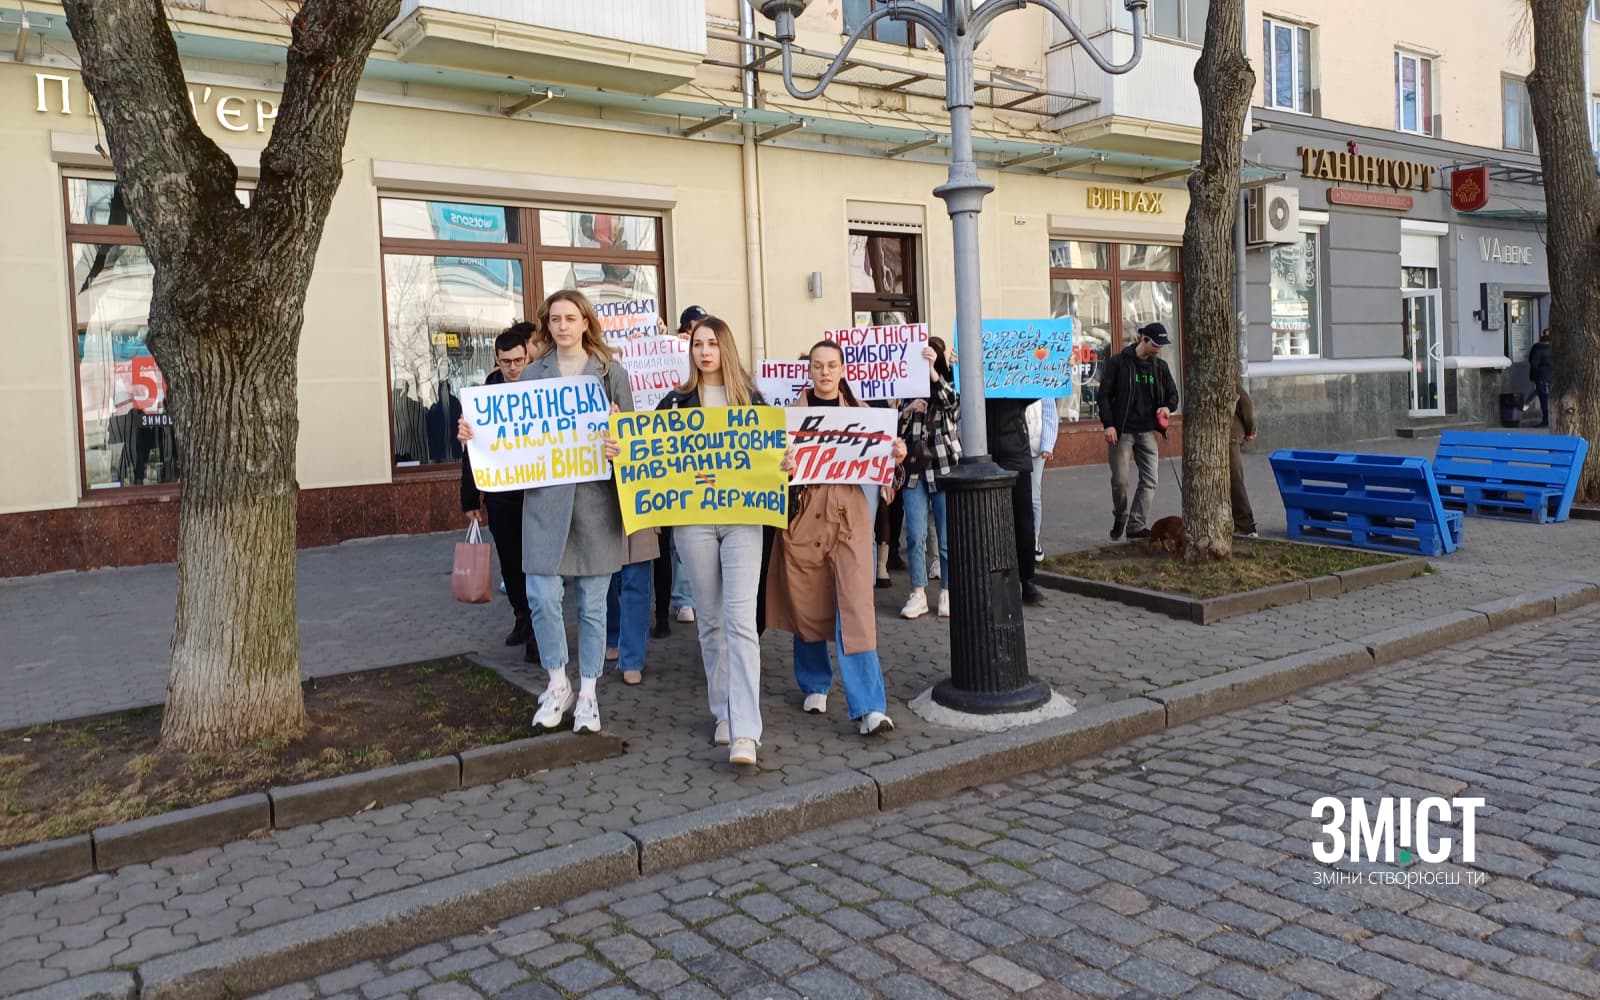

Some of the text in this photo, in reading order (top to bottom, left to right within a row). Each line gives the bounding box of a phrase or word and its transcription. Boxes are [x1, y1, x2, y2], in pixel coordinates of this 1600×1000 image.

[1088, 187, 1164, 213] ВІНТАЖ
[845, 344, 907, 364] ВИБОРУ
[846, 360, 908, 382] ВБИВАЄ
[860, 378, 896, 399] МРІЇ
[474, 383, 608, 426] УКРАЇНСЬКІ
[490, 416, 578, 452] ЛІКАРІ
[617, 408, 760, 439] ПРАВО НА
[630, 429, 787, 462] БЕЗКОШТОВНЕ
[620, 450, 752, 485] НАВЧАННЯ
[635, 484, 786, 516] БОРГ ДЕРЖАВІ
